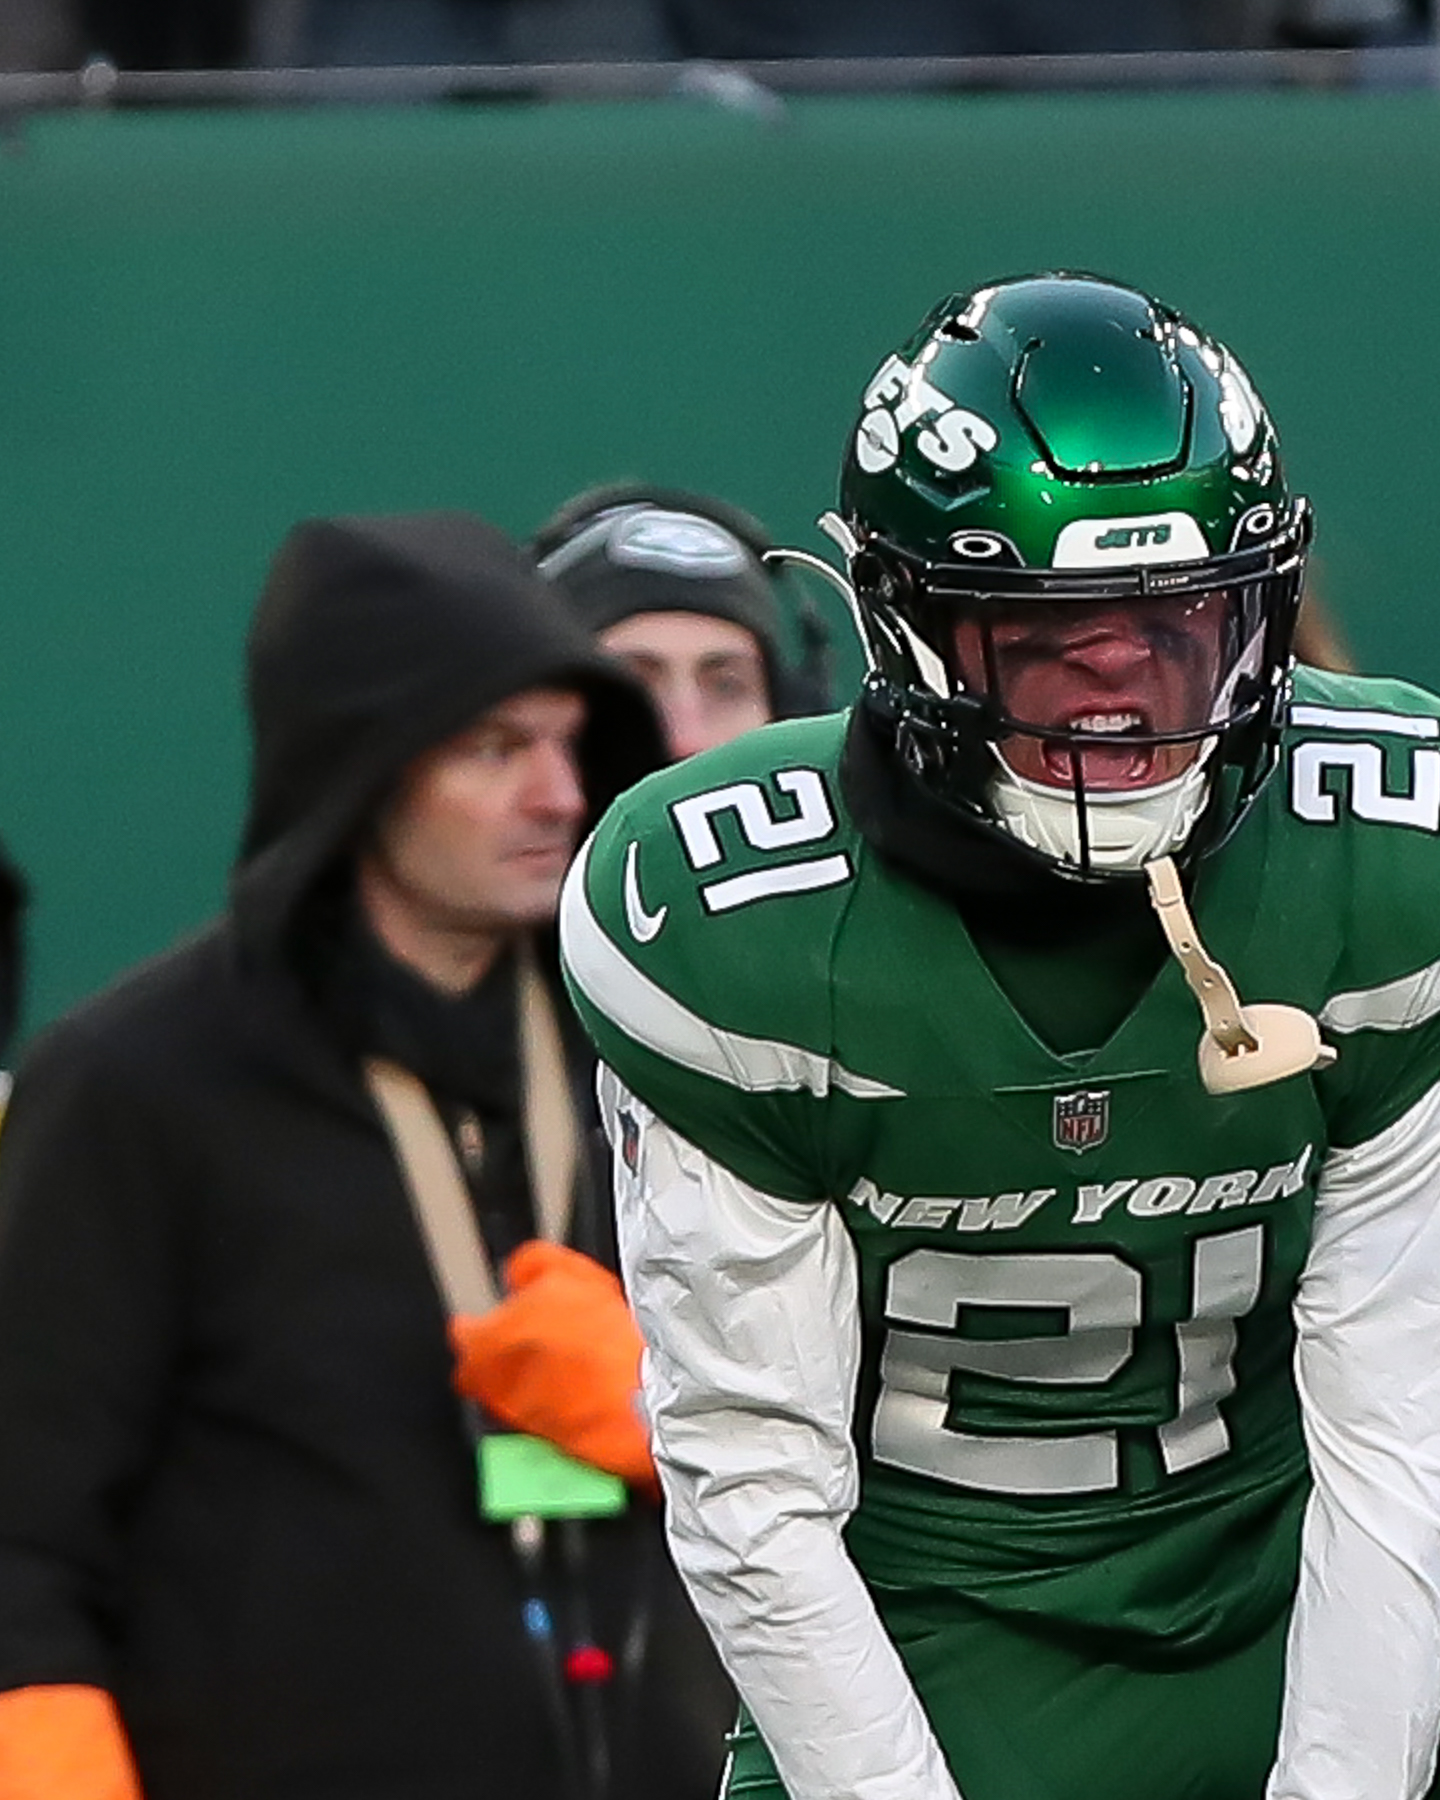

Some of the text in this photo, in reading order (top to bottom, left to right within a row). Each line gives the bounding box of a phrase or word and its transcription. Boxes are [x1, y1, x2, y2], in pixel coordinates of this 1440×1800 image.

[671, 769, 851, 916] 21
[846, 1143, 1313, 1232] NEW YORK
[1060, 1115, 1101, 1142] NFL
[871, 1223, 1262, 1498] 21
